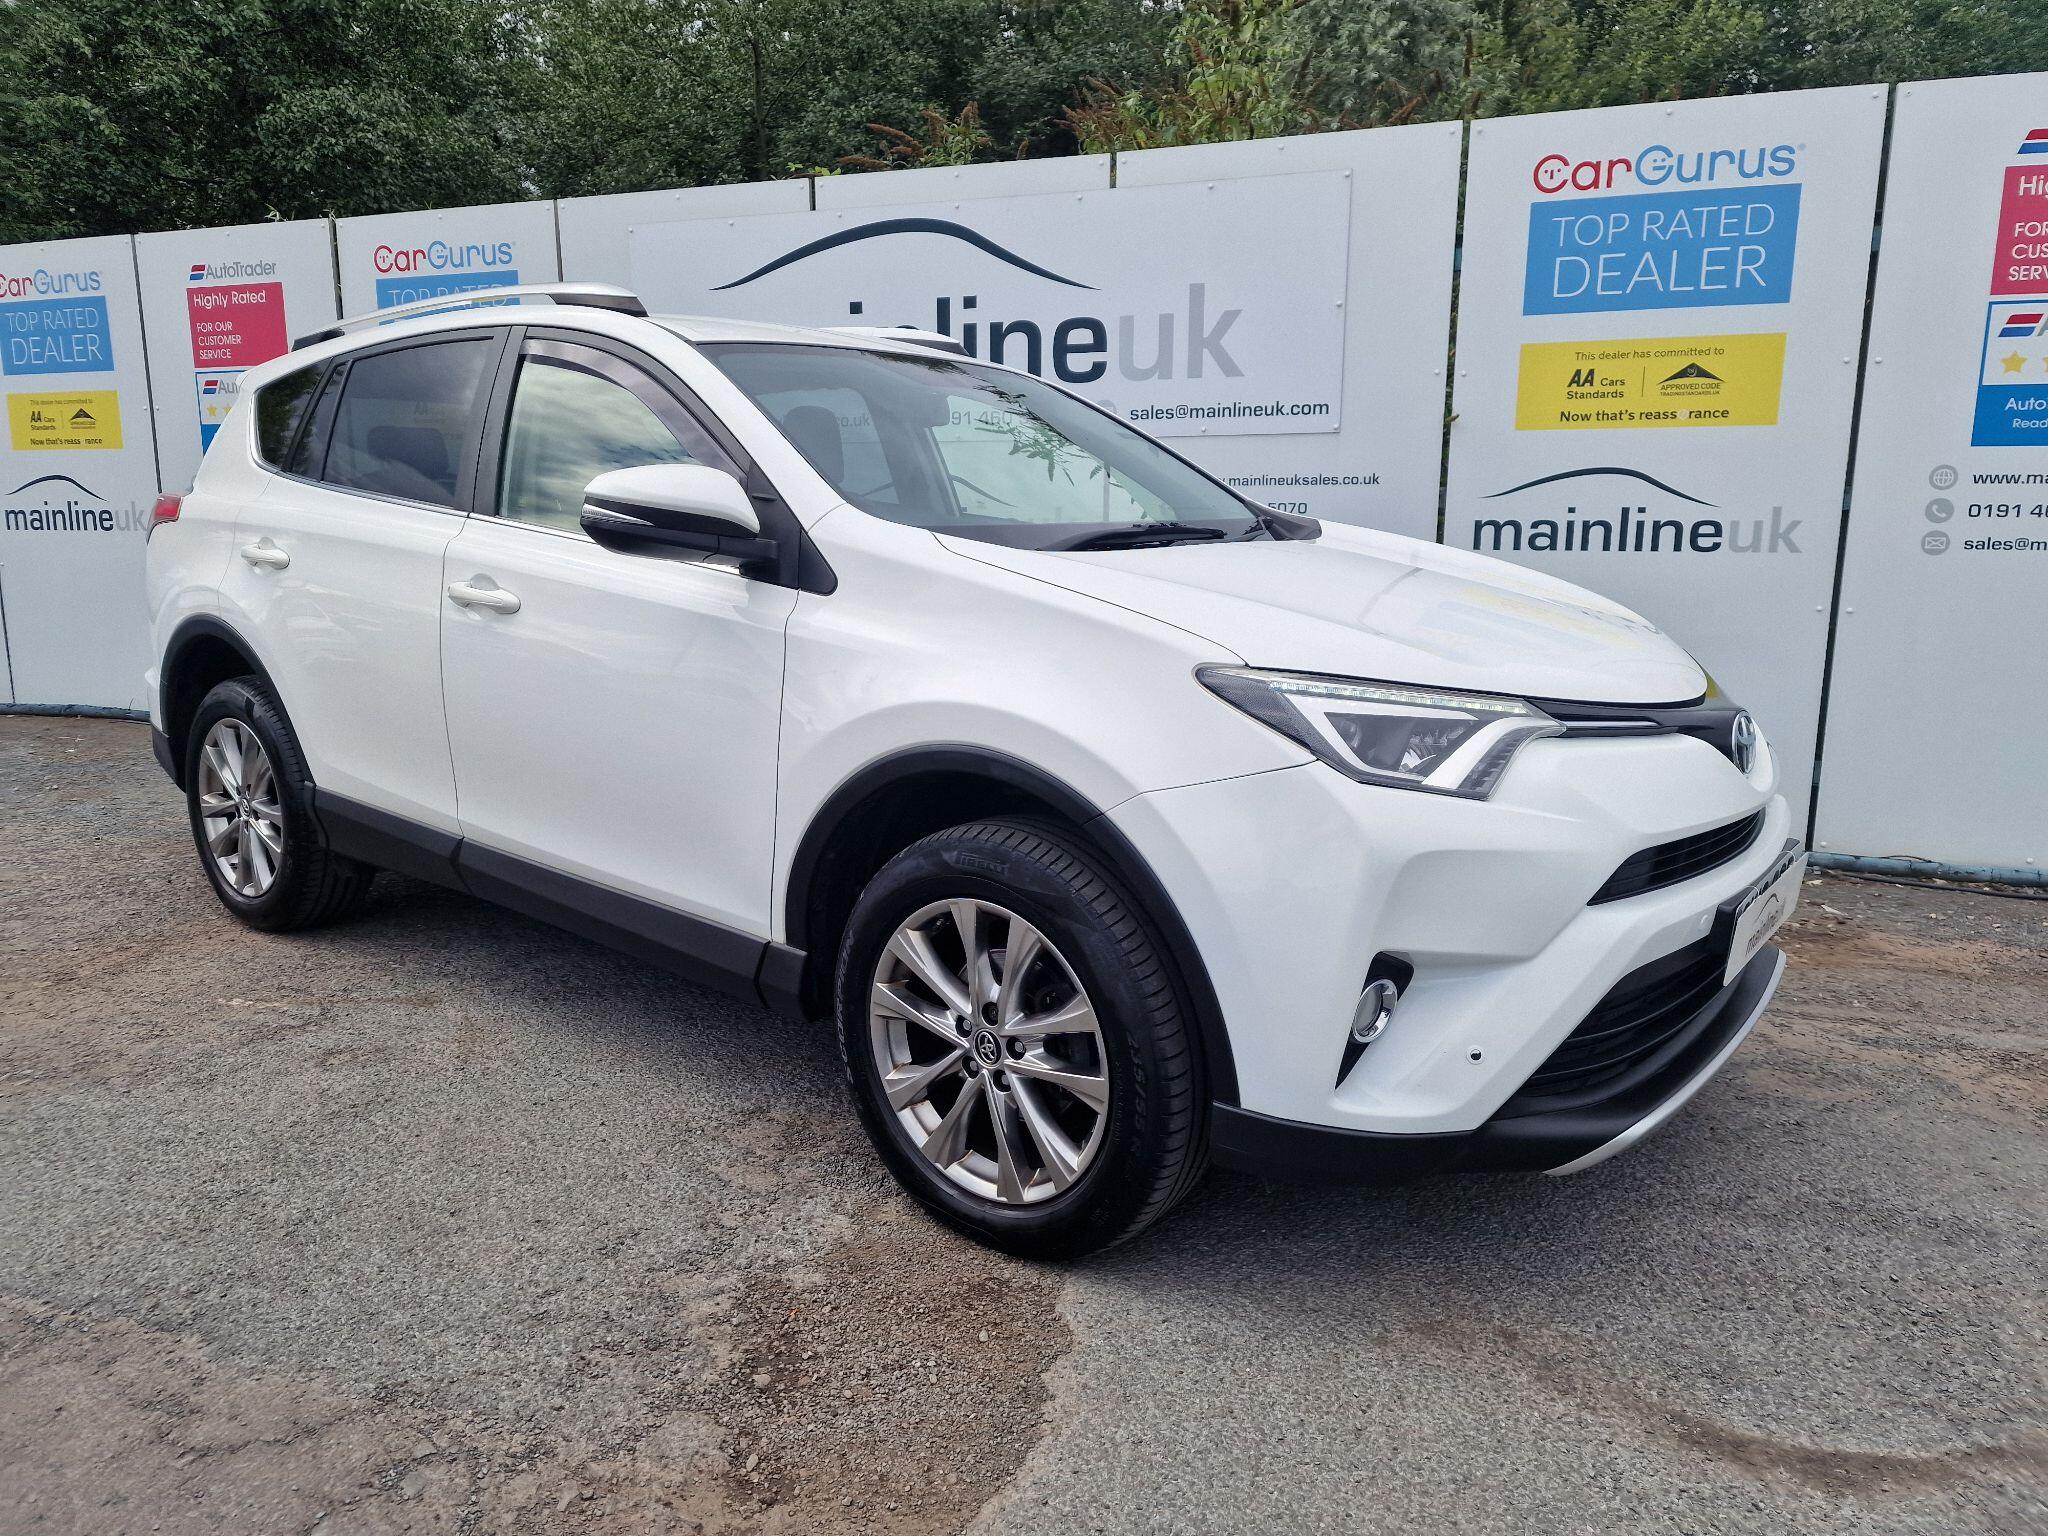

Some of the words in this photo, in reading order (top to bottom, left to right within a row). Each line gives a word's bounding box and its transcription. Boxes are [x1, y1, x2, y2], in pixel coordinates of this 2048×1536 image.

[1533, 144, 1796, 194] CarGurus
[1552, 213, 1630, 247] TOP
[1642, 203, 1775, 242] RATED
[374, 240, 513, 273] CarGurus
[205, 260, 276, 279] AutoTrader
[1553, 245, 1767, 298] DEALER
[193, 292, 228, 309] Highly
[231, 290, 266, 304] Rated
[4, 311, 38, 332] TOP
[42, 307, 99, 330] RATED
[196, 322, 213, 332] FOR
[215, 321, 233, 332] OUR
[11, 333, 103, 365] DEALER
[198, 335, 241, 346] CUSTOMER
[200, 349, 232, 359] SERVICE
[1575, 352, 1597, 361] This
[1598, 350, 1630, 361] dealer
[1633, 349, 1651, 359] has
[1653, 347, 1710, 358] committed
[1714, 347, 1725, 356] to
[1567, 369, 1594, 387] AA
[1600, 377, 1626, 387] Cars
[1660, 383, 1700, 391] APPROVED
[1701, 382, 1721, 390] CODE
[1566, 389, 1624, 400] Standards
[31, 411, 42, 422] AA
[1130, 400, 1330, 420] sales@mainlineuk.com
[1559, 411, 1592, 422] Now
[1639, 409, 1730, 421] reassrance
[1968, 503, 2022, 518] 0191
[1472, 507, 1803, 553] mainlineuk
